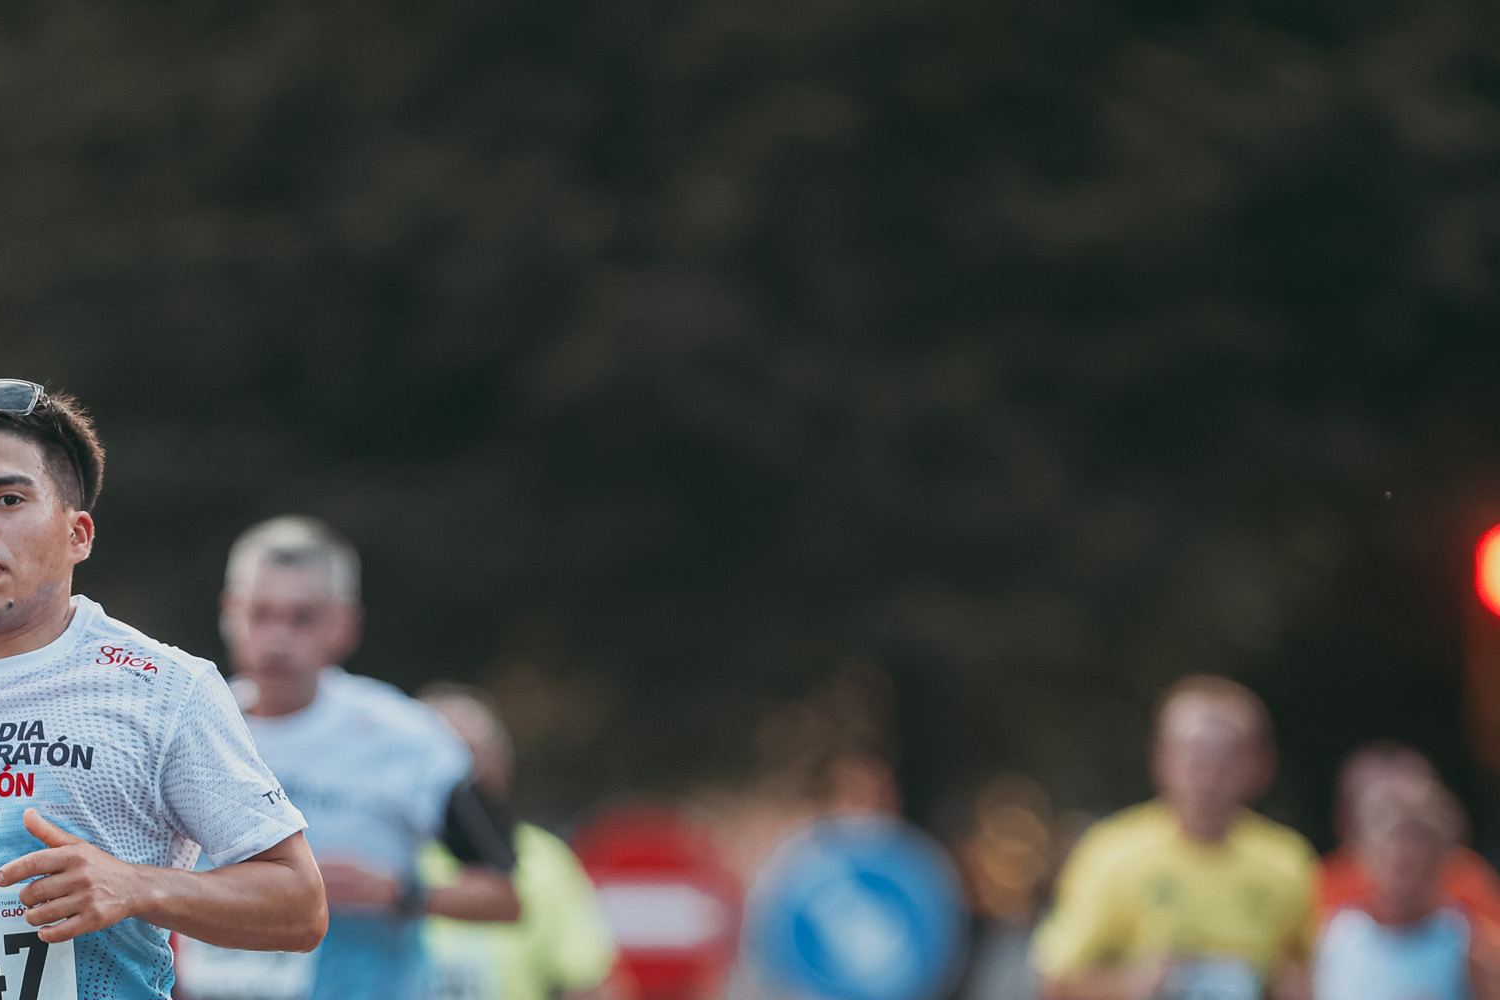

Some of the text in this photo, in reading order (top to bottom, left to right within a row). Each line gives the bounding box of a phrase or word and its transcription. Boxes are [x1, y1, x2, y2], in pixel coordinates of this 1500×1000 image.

[96, 646, 158, 674] gijón
[120, 666, 151, 683] deporte
[1, 906, 26, 917] GIJÓ
